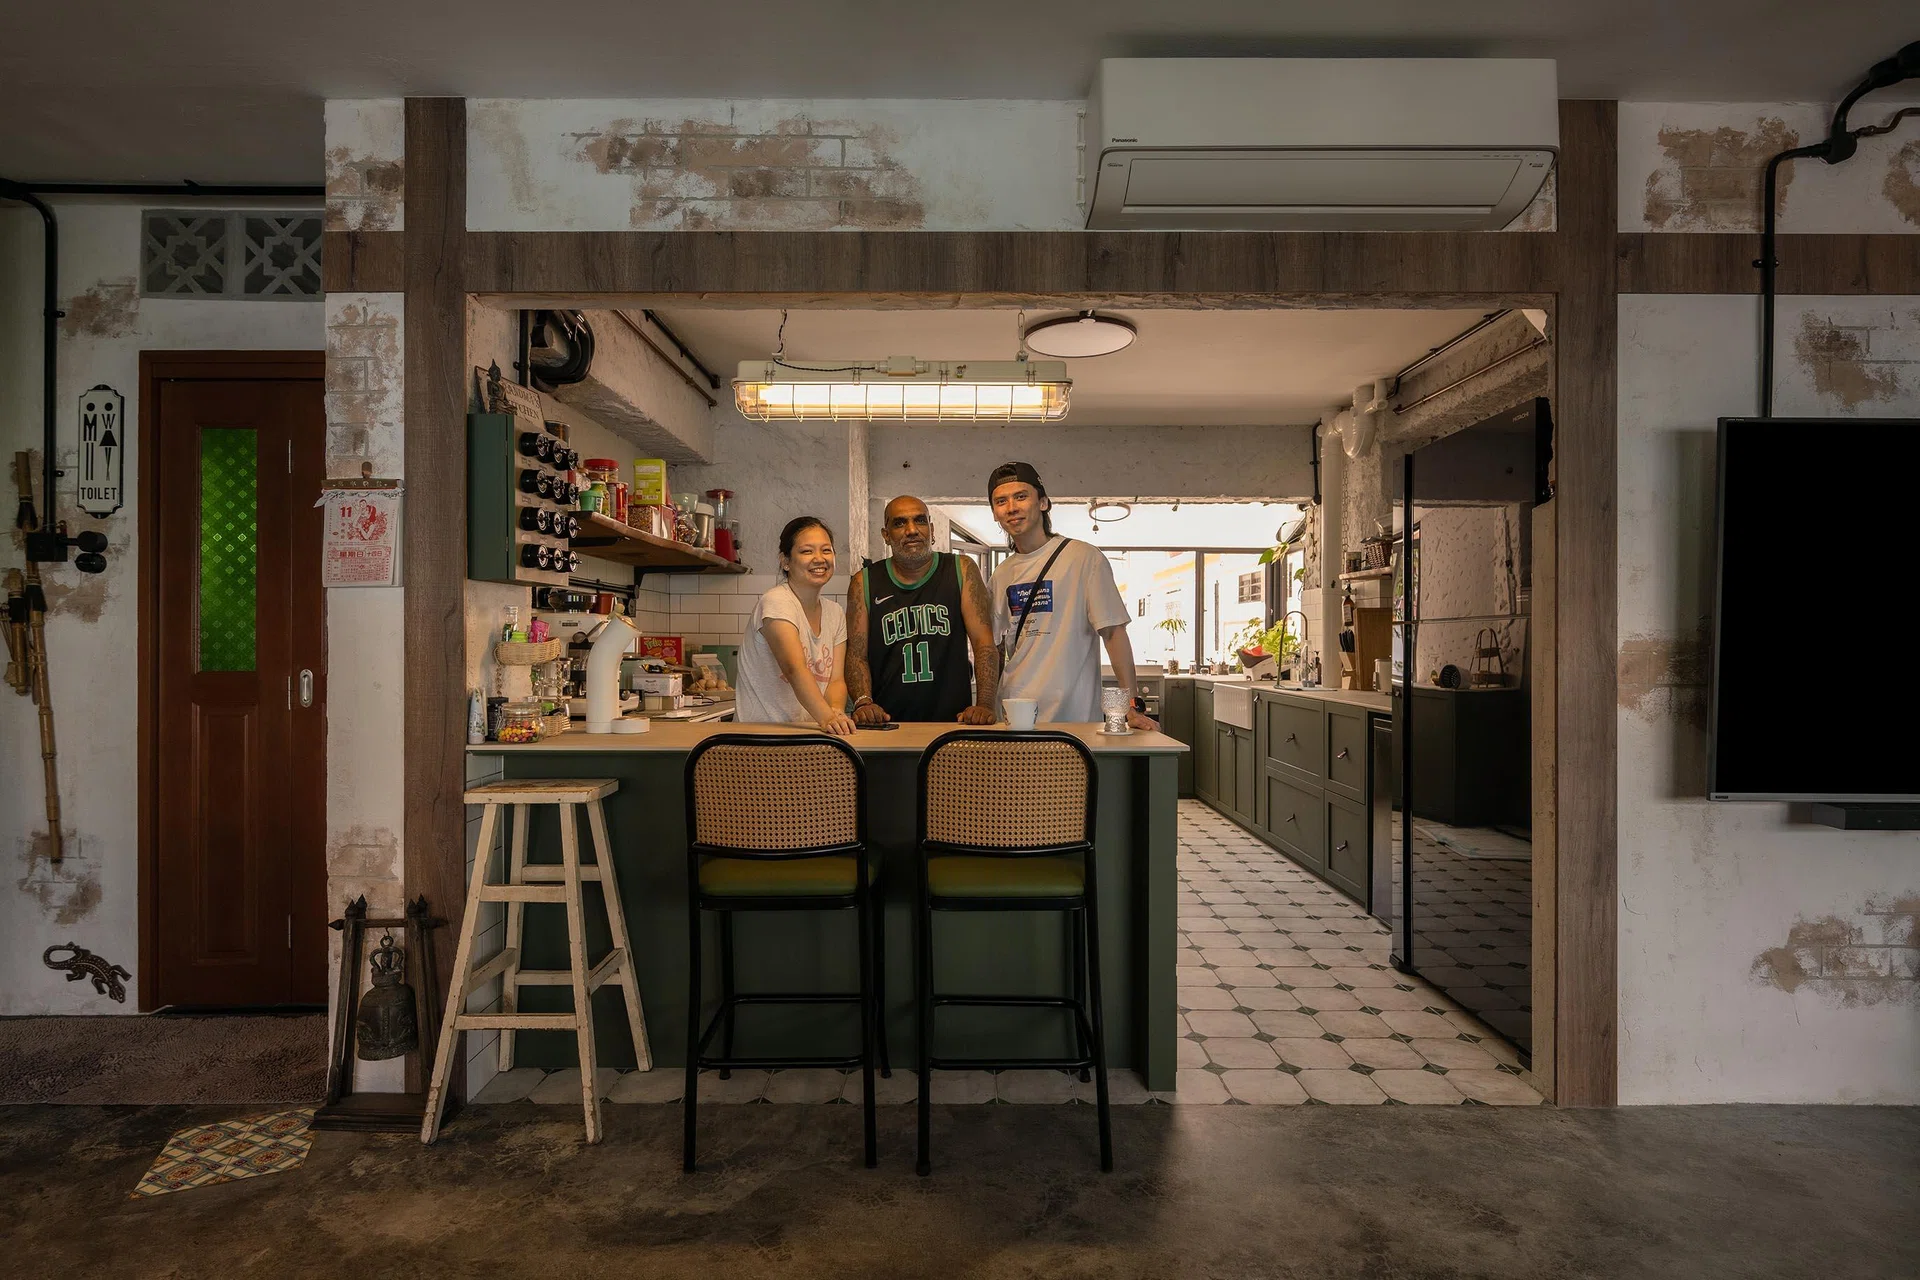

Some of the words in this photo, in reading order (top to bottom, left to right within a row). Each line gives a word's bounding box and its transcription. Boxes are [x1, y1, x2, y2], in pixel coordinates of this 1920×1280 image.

[80, 487, 117, 500] TOILET
[340, 506, 352, 518] 11
[881, 604, 951, 646] CELTICS
[901, 641, 934, 684] 11
